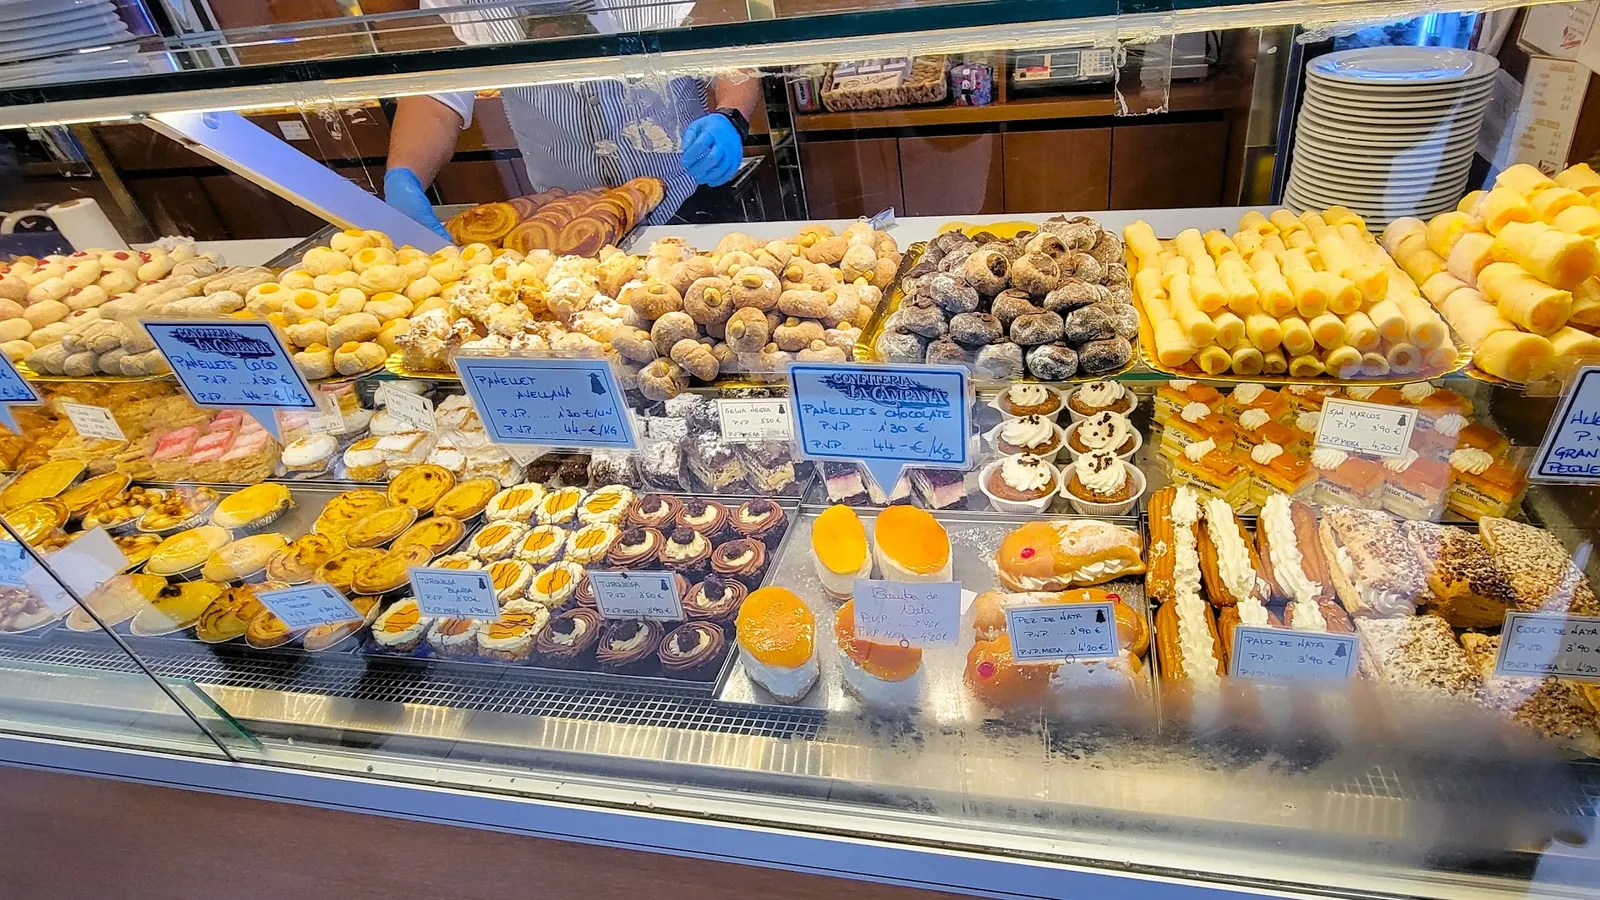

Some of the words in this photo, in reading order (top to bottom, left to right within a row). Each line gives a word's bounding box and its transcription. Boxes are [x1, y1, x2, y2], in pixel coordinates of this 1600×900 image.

[171, 352, 238, 371] PANELLETS
[280, 376, 292, 385] €
[517, 385, 572, 401] AVELLANA
[849, 385, 869, 400] LA
[870, 384, 949, 405] CAMPANA
[802, 400, 877, 416] PANELLETS
[884, 409, 952, 421] CHOCOLATE
[1327, 406, 1344, 418] SAN
[1349, 411, 1381, 420] MARCOS
[913, 425, 929, 433] €
[1393, 427, 1402, 435] €
[1393, 444, 1400, 452] €
[926, 590, 940, 599] de
[1013, 616, 1037, 625] PEZ
[1060, 611, 1083, 621] NATA
[1516, 625, 1546, 634] COCA
[1552, 628, 1567, 636] DE
[1571, 624, 1599, 636] NATA
[1297, 638, 1325, 648] NATA
[1327, 657, 1336, 665] €
[1533, 663, 1559, 672] MESA
